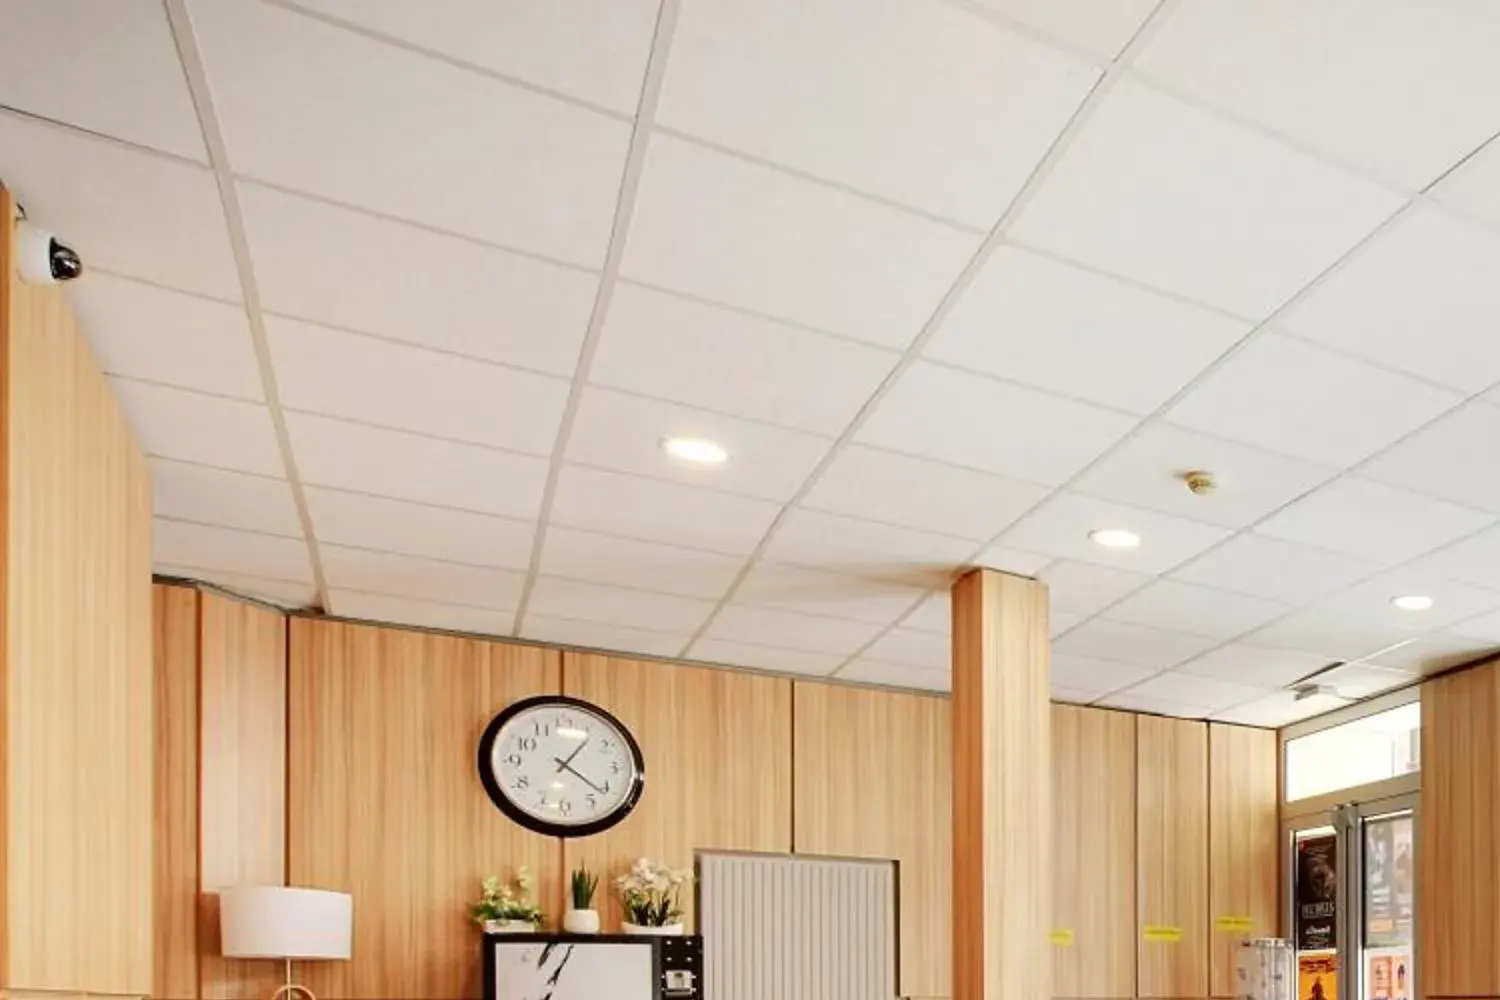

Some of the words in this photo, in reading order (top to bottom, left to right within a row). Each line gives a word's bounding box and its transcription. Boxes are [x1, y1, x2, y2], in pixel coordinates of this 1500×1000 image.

[535, 723, 549, 736] 11
[518, 738, 537, 751] 10
[509, 753, 521, 767] 9
